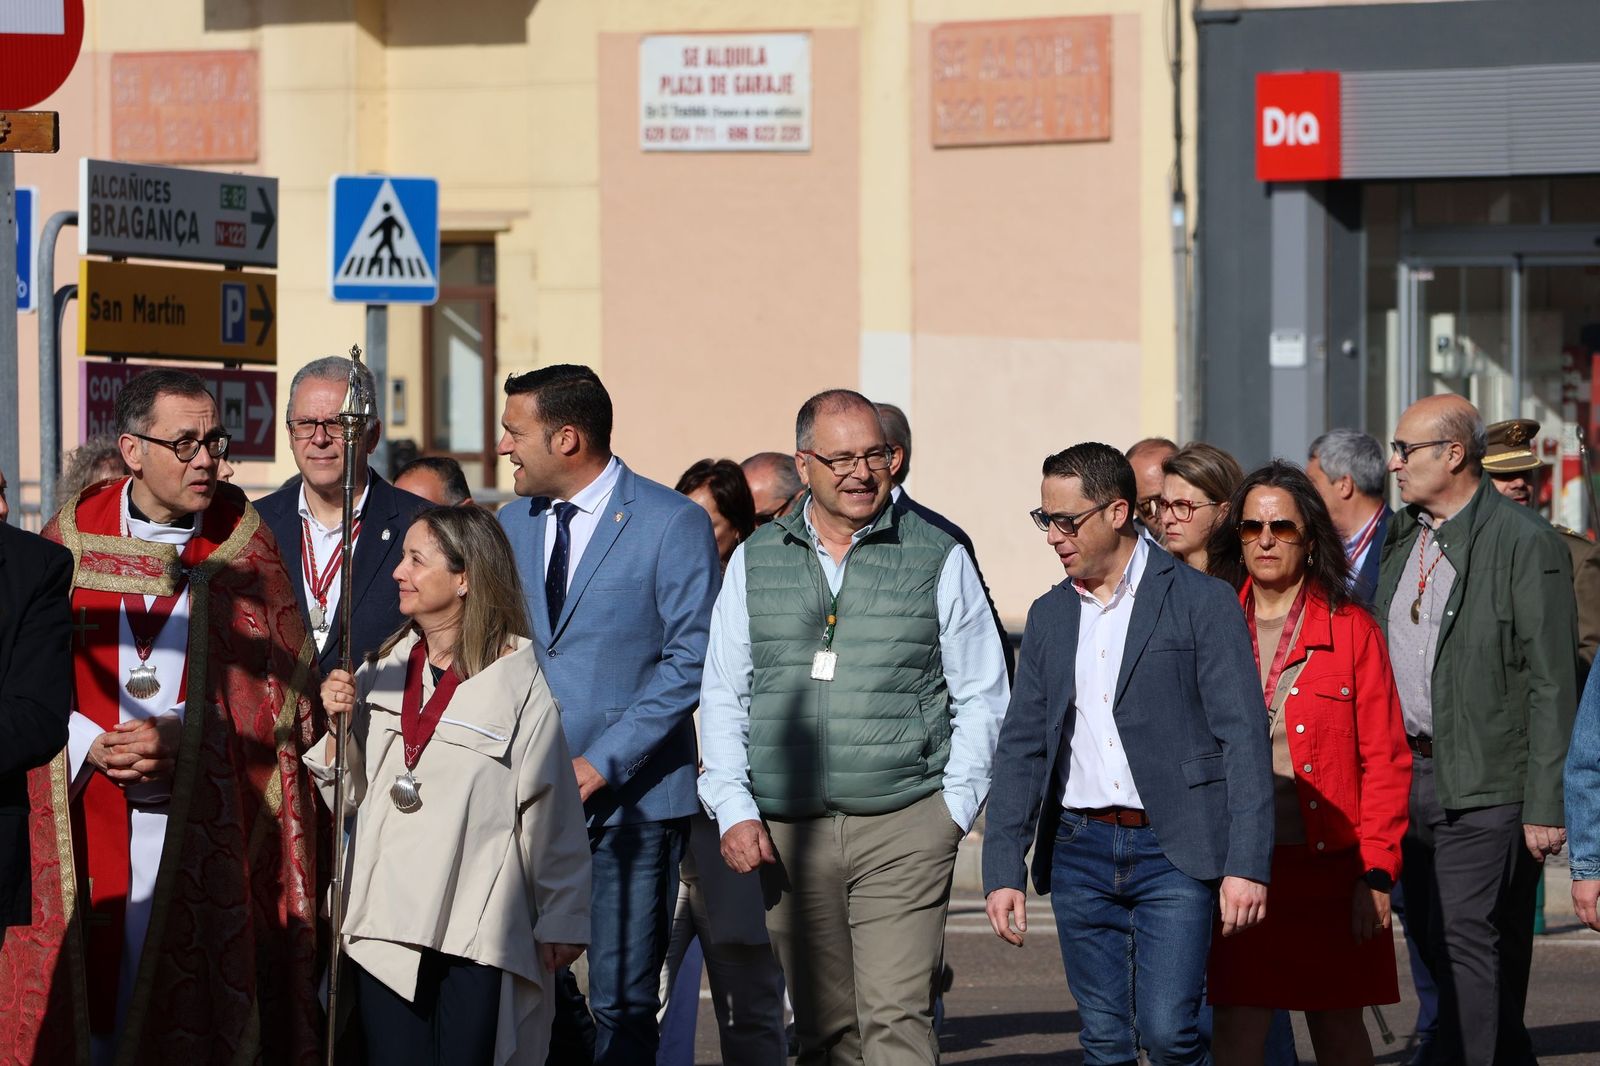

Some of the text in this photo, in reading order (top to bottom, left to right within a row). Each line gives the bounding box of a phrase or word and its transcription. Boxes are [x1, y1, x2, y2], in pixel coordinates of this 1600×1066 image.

[682, 46, 768, 68] SE ALQUILA
[660, 74, 794, 96] PLAZA DE GARAJE
[91, 172, 171, 204] ALCAÑICES
[221, 186, 246, 209] E-82
[90, 202, 200, 247] BRAGANÇA
[216, 223, 245, 246] N-122
[90, 291, 122, 322] San
[225, 288, 243, 340] P
